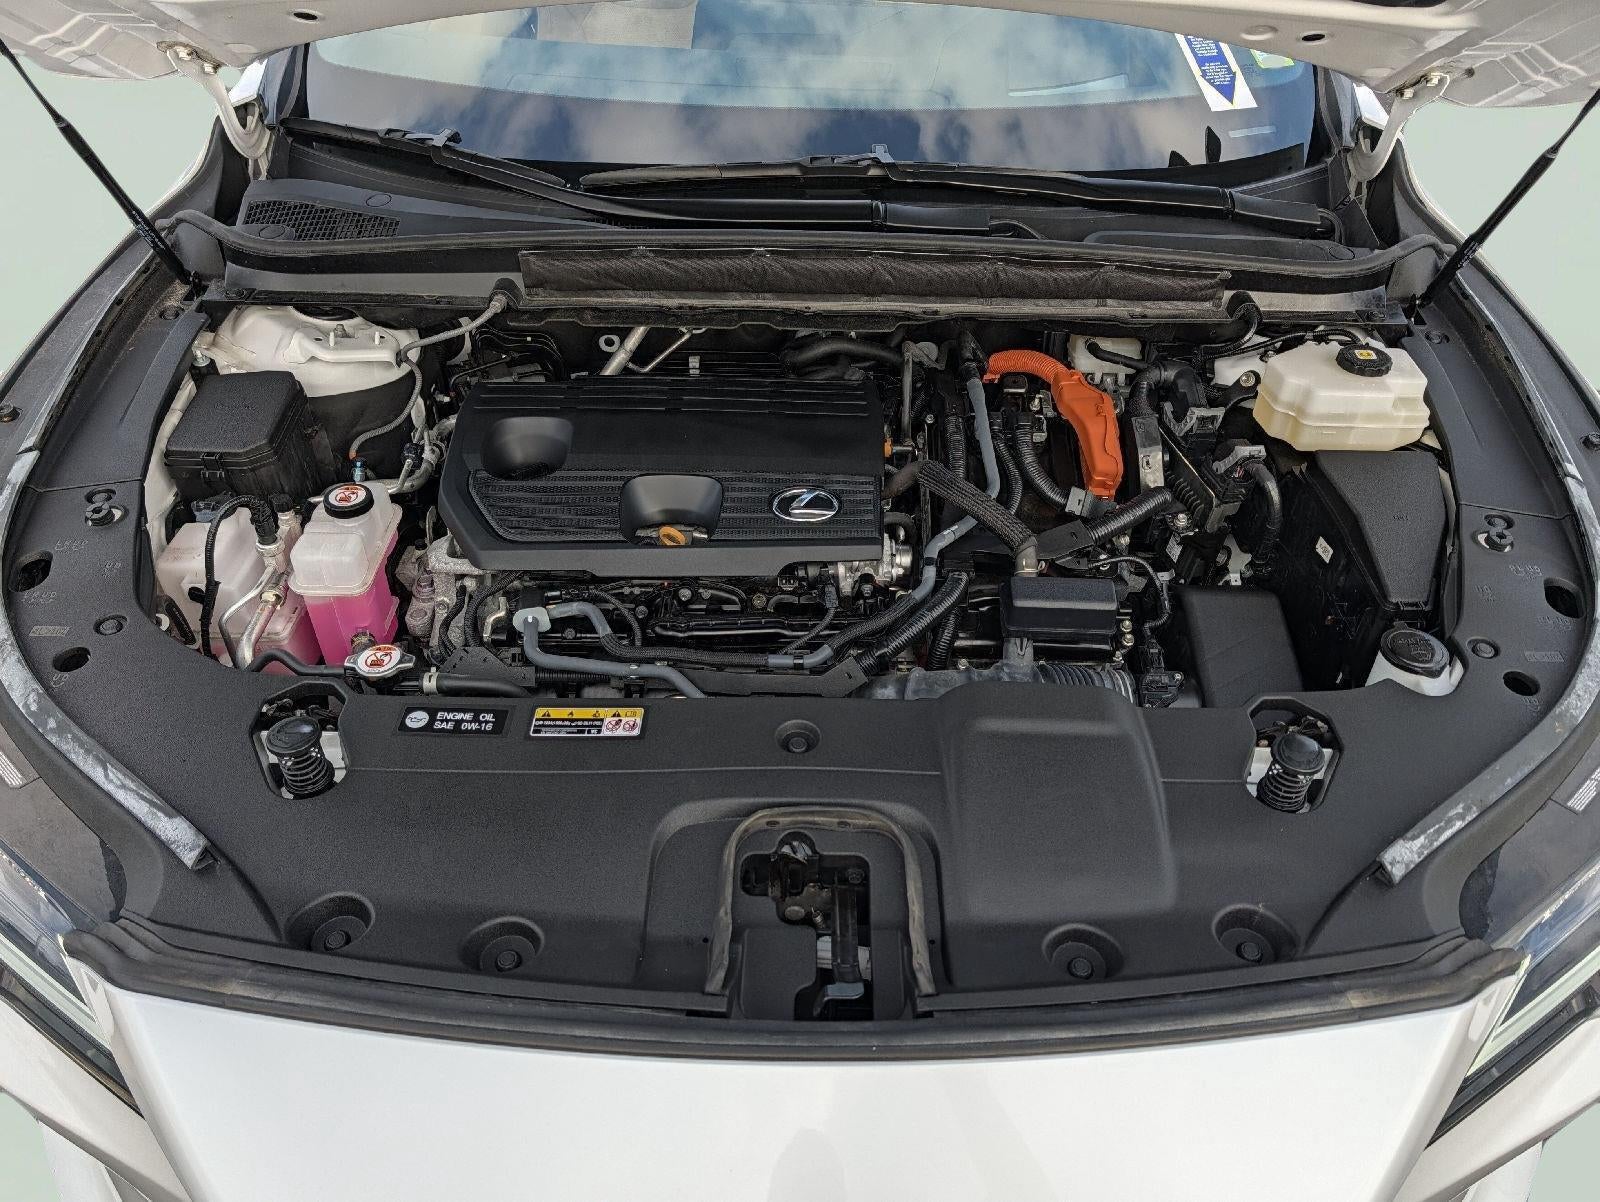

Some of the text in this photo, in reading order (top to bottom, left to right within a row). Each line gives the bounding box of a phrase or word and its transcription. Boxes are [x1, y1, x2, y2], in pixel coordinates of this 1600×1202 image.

[437, 712, 496, 722] ENGINE OIL
[433, 721, 494, 731] SAE 0W-16
